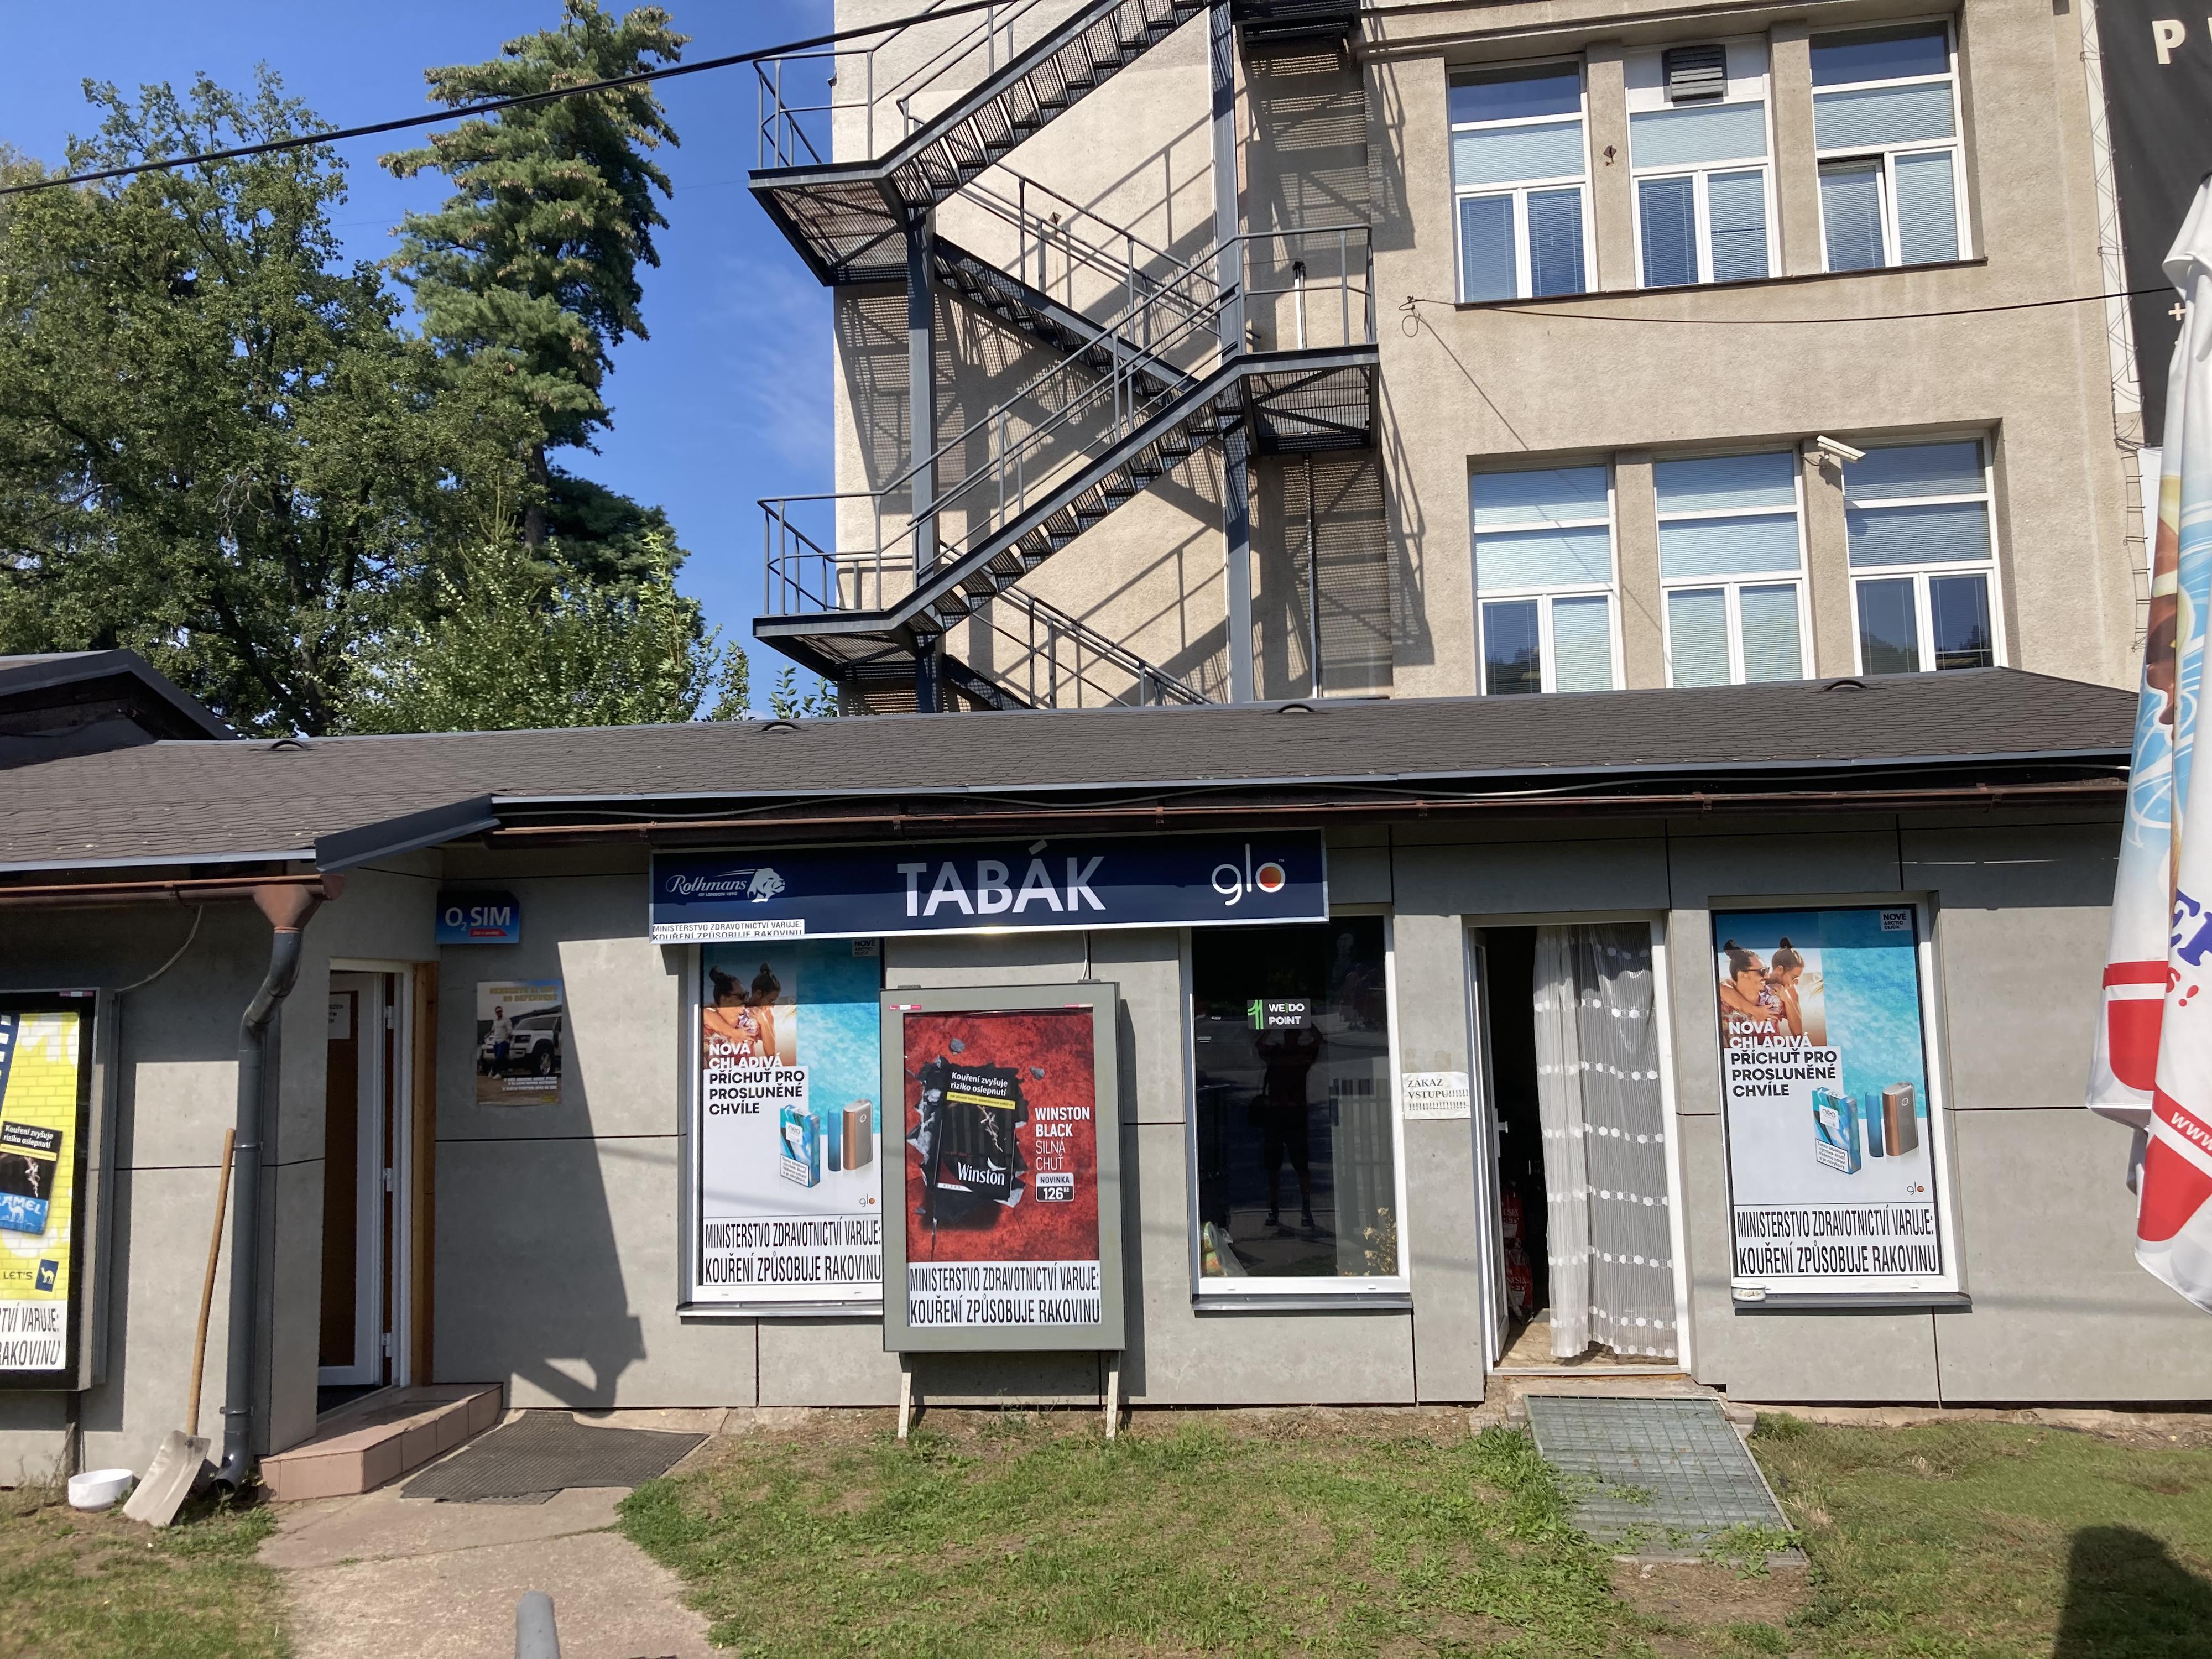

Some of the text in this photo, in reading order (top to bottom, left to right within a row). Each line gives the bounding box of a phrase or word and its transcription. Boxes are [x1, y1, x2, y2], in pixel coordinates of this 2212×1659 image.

[898, 839, 1105, 916] TABÁK
[1212, 843, 1286, 906] glo
[666, 875, 747, 895] Rothmans
[471, 907, 510, 927] SIM
[1883, 911, 1907, 920] NOVÉ
[653, 924, 708, 932] MINISTERSTVO
[711, 920, 769, 930] ZDRAVOTNICTVÍ
[1269, 1016, 1301, 1025] POINT
[1729, 1019, 1775, 1034] NOVÁ
[709, 1040, 750, 1056] NOVÁ
[1729, 1032, 1812, 1049] CHLADIVÁ
[709, 1053, 784, 1070] CHLADIVÁ
[1731, 1048, 1837, 1065] PŘÍCHUŤ PRO
[709, 1070, 805, 1084] PŘÍCHUŤ PRO
[951, 1071, 1008, 1088] Kouření zvyšuje
[1733, 1064, 1835, 1081] PROSLUNĚNÉ
[951, 1081, 1006, 1096] riziko oslepnutí
[1407, 1078, 1443, 1087] ZÁKAZ
[1733, 1082, 1790, 1097] CHVÍLE
[709, 1083, 802, 1100] PROSLUNĚNÉ
[709, 1100, 759, 1115] CHVÍLE
[1035, 1107, 1090, 1121] WINSTON
[1822, 1108, 1836, 1118] neo
[5, 1125, 53, 1140] Kouření zvyšuje
[788, 1125, 801, 1135] neo
[1035, 1123, 1073, 1137] BLACK
[3, 1134, 51, 1149] riziko oslepnutí
[1036, 1136, 1066, 1154] SILNÁ
[1036, 1154, 1063, 1171] CHUŤ
[958, 1161, 1005, 1186] Winston
[1043, 1187, 1063, 1200] 126
[1907, 1181, 1924, 1195] glo
[0, 1196, 42, 1215] AMEL
[859, 1194, 875, 1207] glo
[1737, 1204, 1934, 1238] MINISTERSTVO ZDRAVOTNICTVÍ VARUJE:
[705, 1216, 881, 1249] MINISTERSTVO ZDRAVOTNICTVÍ VARUJE:
[1739, 1240, 1936, 1274] KOUŘENÍ ZPŮSOBUJE RAKOVINU
[705, 1250, 881, 1283] KOUŘENÍ ZPŮSOBUJE RAKOVINU
[3, 1271, 33, 1280] LET'S
[910, 1262, 1099, 1292] MINISTERSTVO ZDRAVOTNICTVÍ VARUJE:
[911, 1293, 1099, 1323] KOUŘENÍ ZPŮSOBUJE RAKOVINU
[0, 1302, 59, 1332] TVÍ VARUJE:
